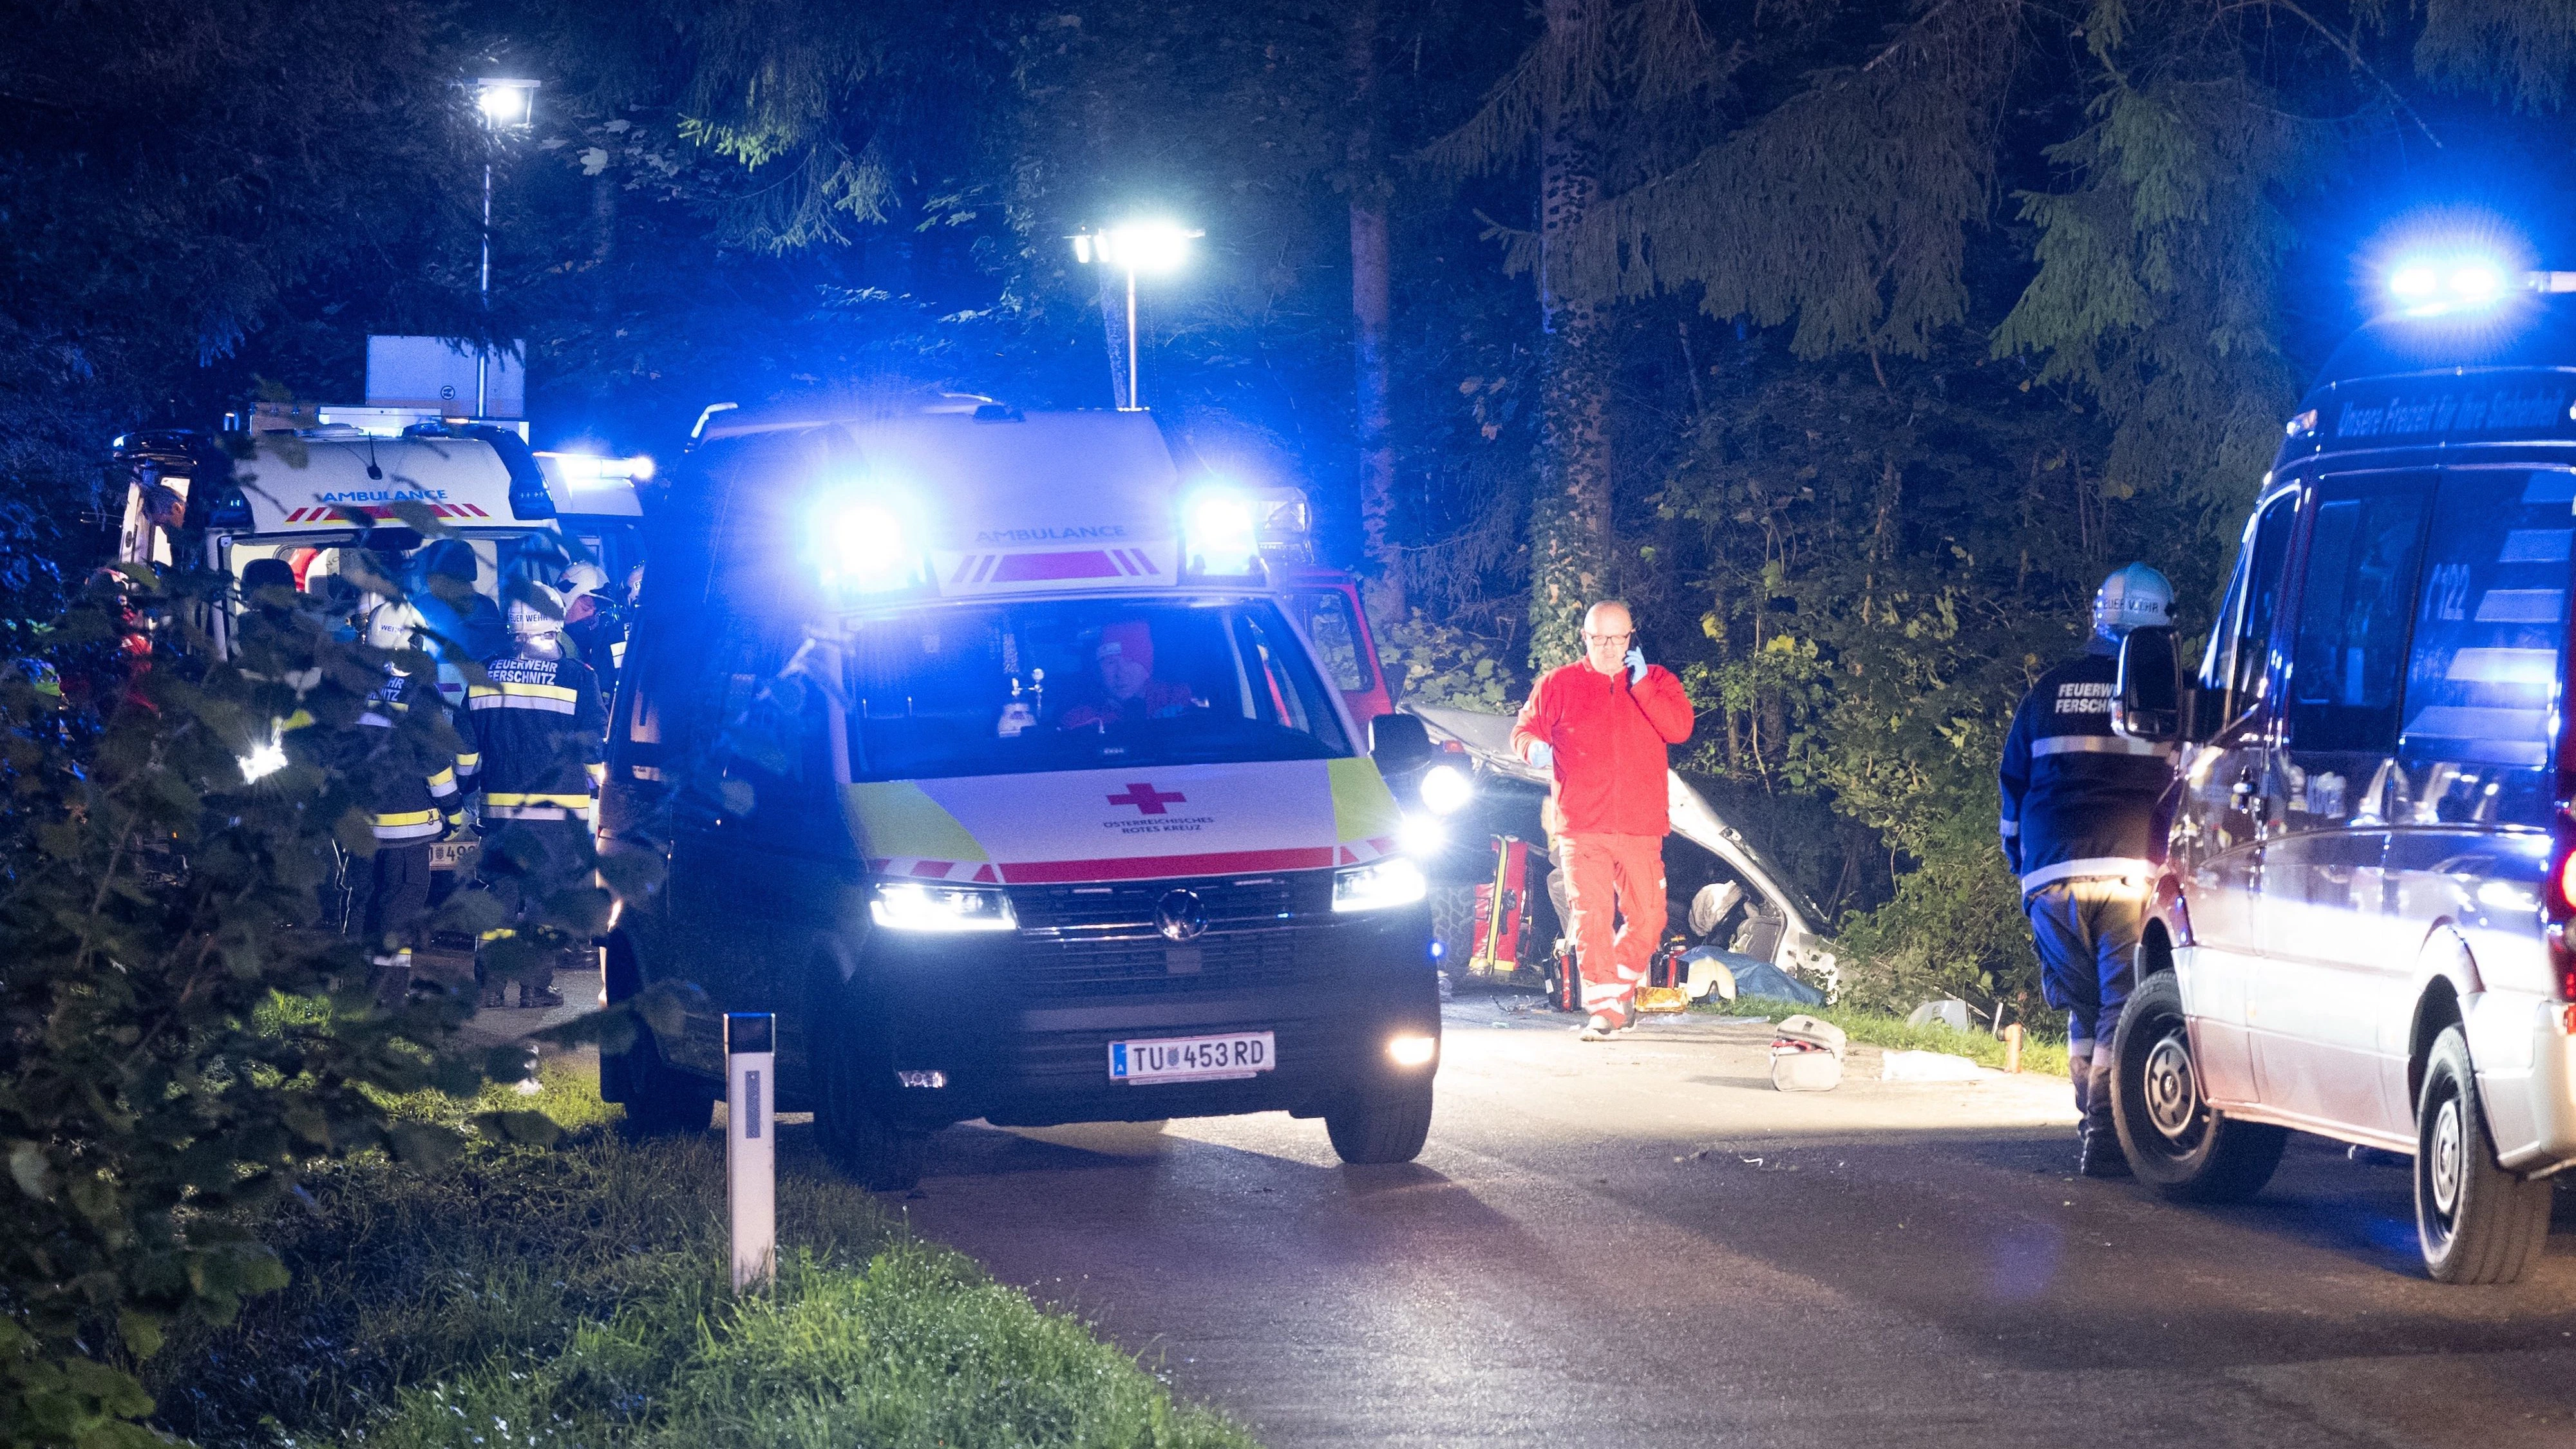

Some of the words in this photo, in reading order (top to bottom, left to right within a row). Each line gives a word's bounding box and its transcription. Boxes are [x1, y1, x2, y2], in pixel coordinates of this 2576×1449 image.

[323, 489, 448, 502] AMBULANCE
[975, 526, 1126, 542] AMBULANCE
[489, 659, 558, 672] FEUERWEHR
[488, 670, 556, 685] FERSCHNITZ
[1121, 826, 1160, 834] ROTES
